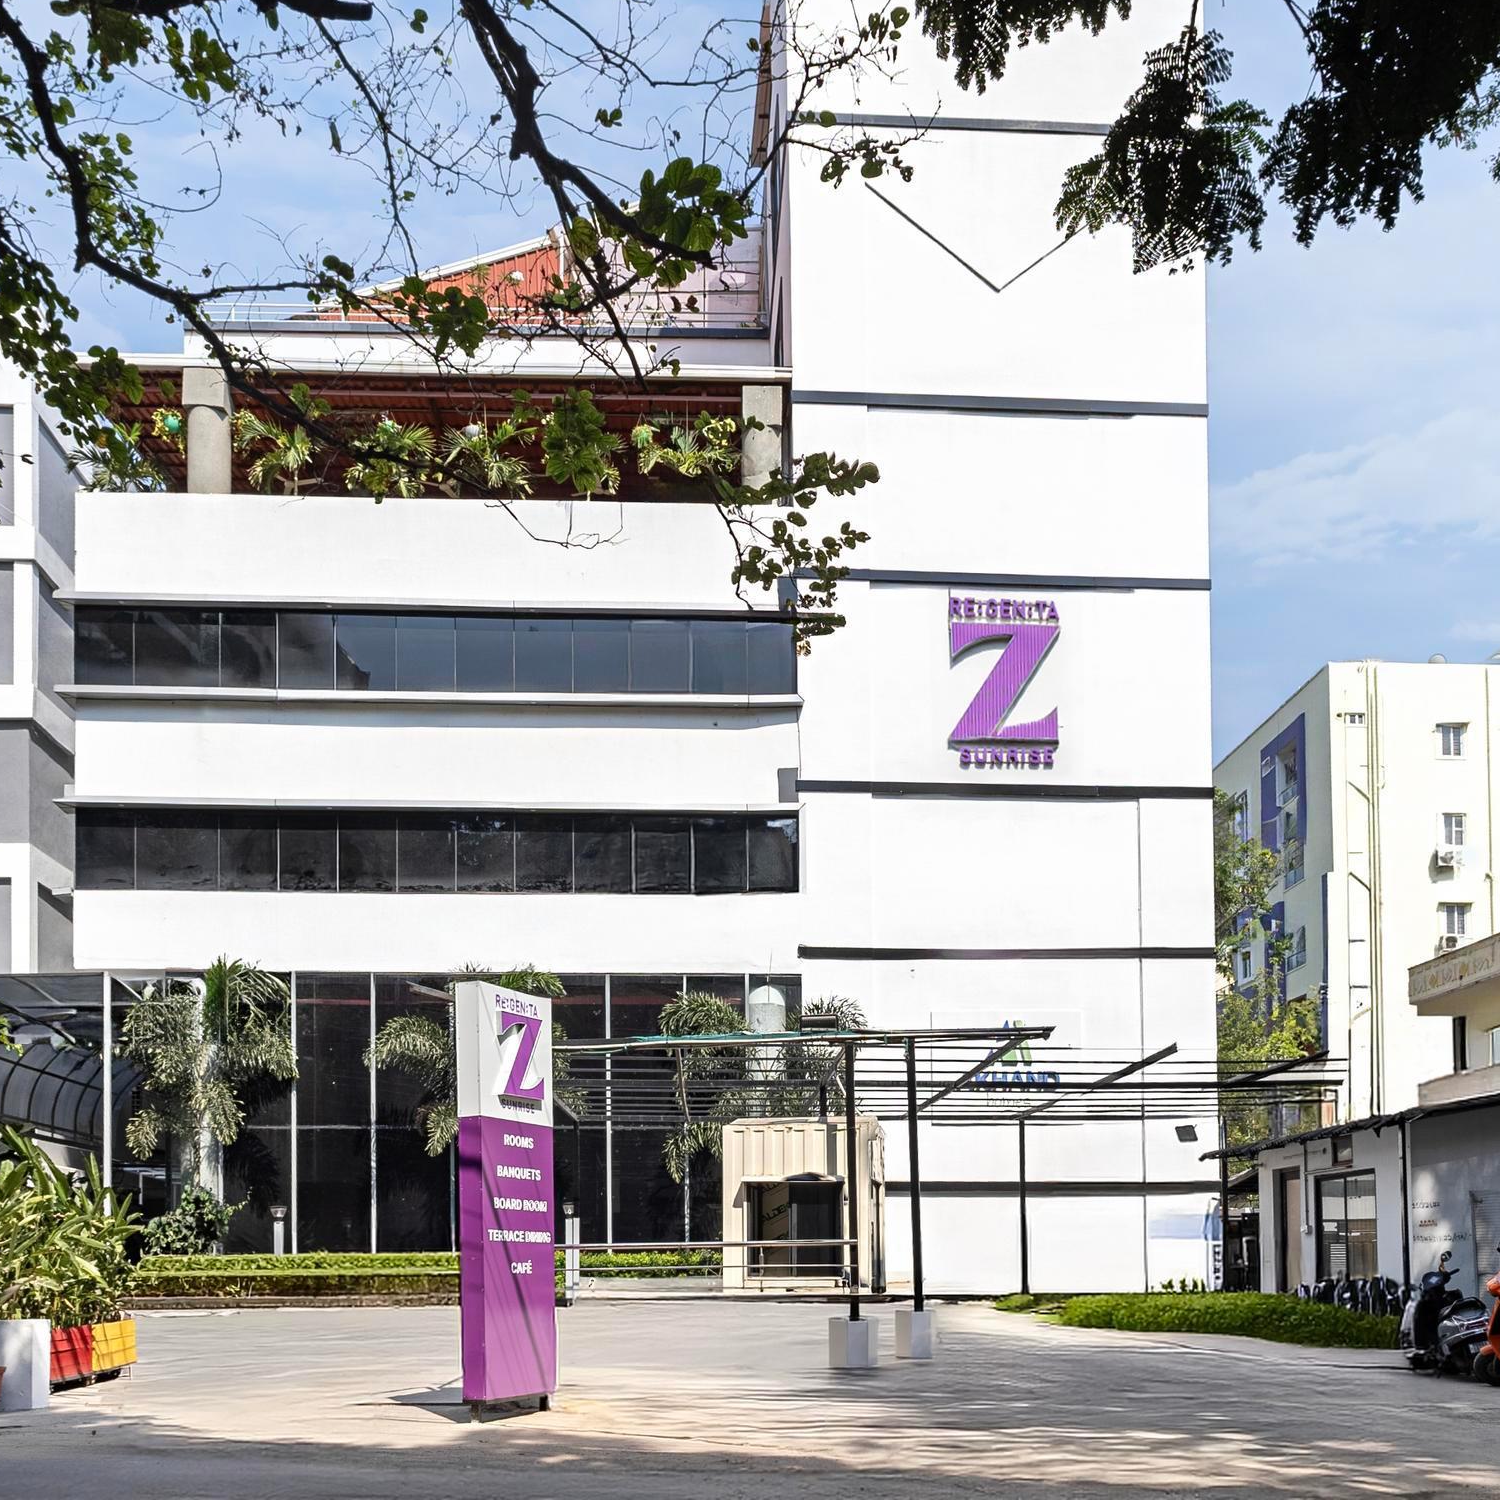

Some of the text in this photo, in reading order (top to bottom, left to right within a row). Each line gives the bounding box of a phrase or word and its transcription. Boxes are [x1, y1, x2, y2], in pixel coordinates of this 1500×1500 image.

[949, 622, 1061, 743] Z
[959, 747, 1055, 765] SUNRISE
[498, 1011, 544, 1100] Z
[501, 1098, 535, 1114] SUNRISE
[503, 1133, 535, 1149] ROOMS
[496, 1165, 542, 1181] BANQUETS
[493, 1197, 548, 1212] BOARD ROOM
[488, 1229, 552, 1244] TERRACE DINING
[510, 1259, 533, 1275] CAFÉ
